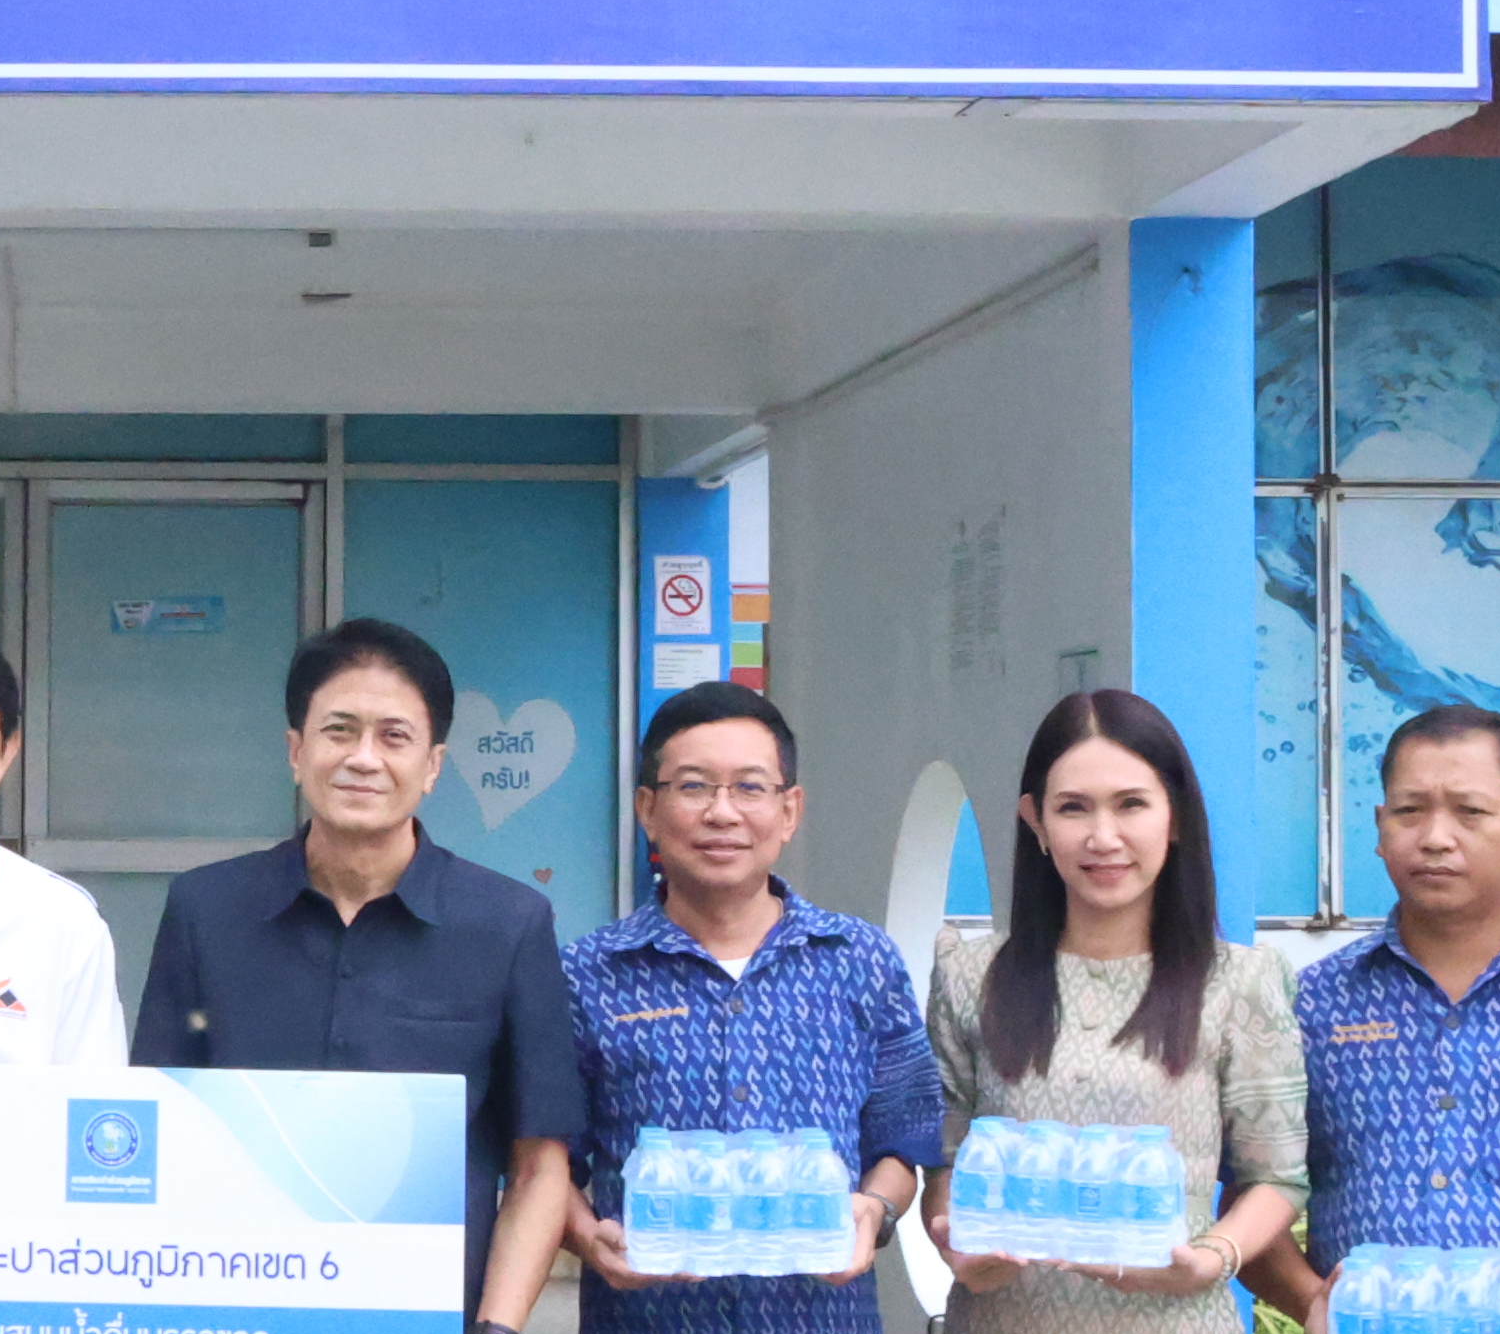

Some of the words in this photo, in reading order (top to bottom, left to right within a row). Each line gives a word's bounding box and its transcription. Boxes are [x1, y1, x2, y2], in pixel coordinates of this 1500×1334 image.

[476, 730, 535, 755] สวัสดี
[480, 766, 530, 790] ครับ!
[319, 1251, 340, 1281] 6
